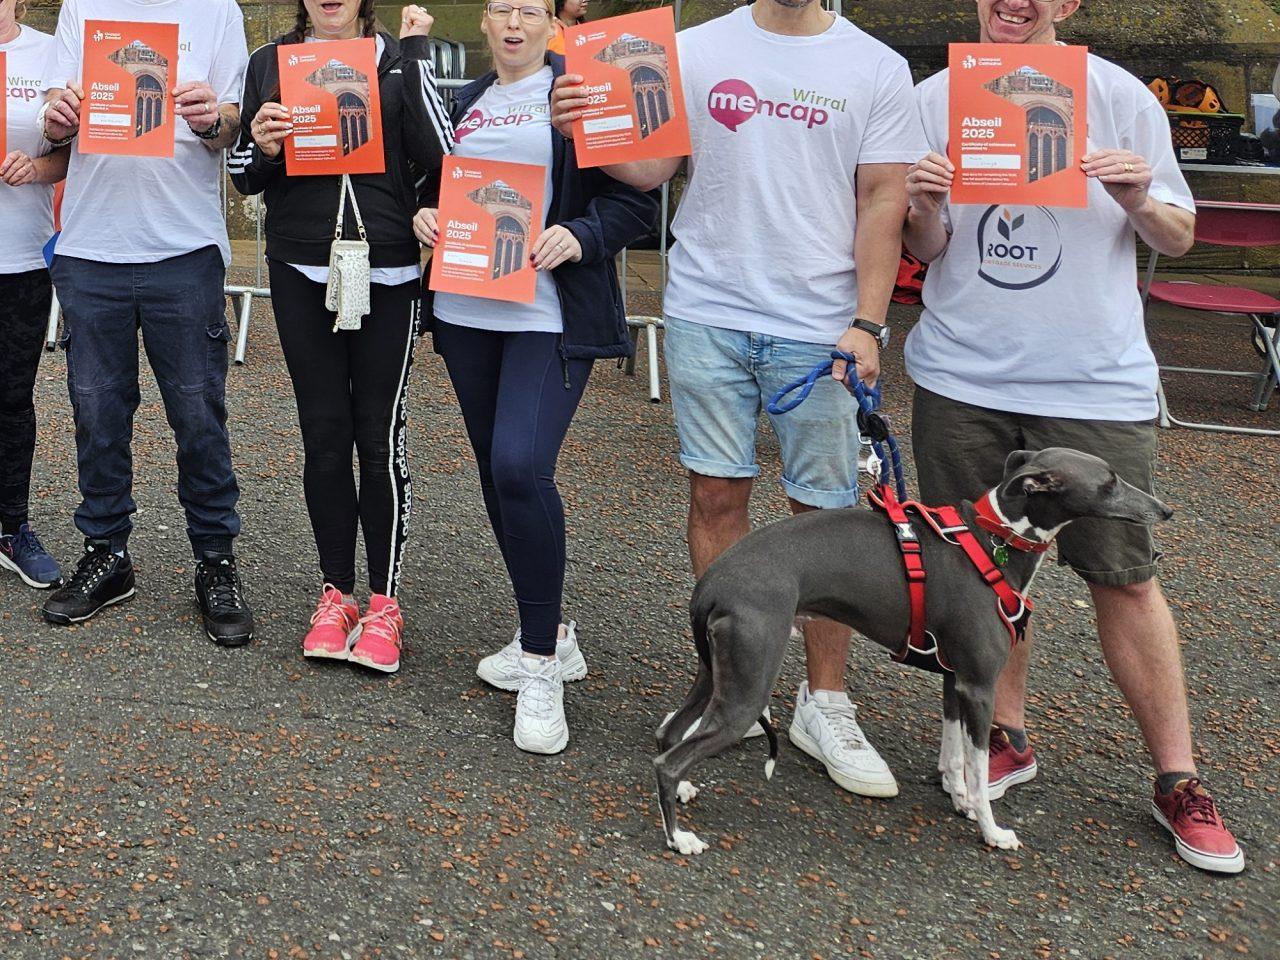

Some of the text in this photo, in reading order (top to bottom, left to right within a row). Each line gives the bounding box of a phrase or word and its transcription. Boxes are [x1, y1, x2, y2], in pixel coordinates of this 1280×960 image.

[7, 76, 41, 87] Wirra
[91, 82, 119, 91] Abseil
[582, 82, 612, 94] bseil
[90, 91, 115, 101] 2025
[587, 94, 608, 105] 025
[793, 88, 847, 112] Wirral
[291, 105, 321, 114] Abseil
[710, 92, 829, 129] mencap
[292, 115, 317, 123] 2025
[961, 117, 1002, 127] Abseil
[961, 128, 995, 139] 2025
[447, 220, 478, 231] Abseil
[446, 230, 472, 240] 2025
[986, 243, 1038, 261] ROOT
